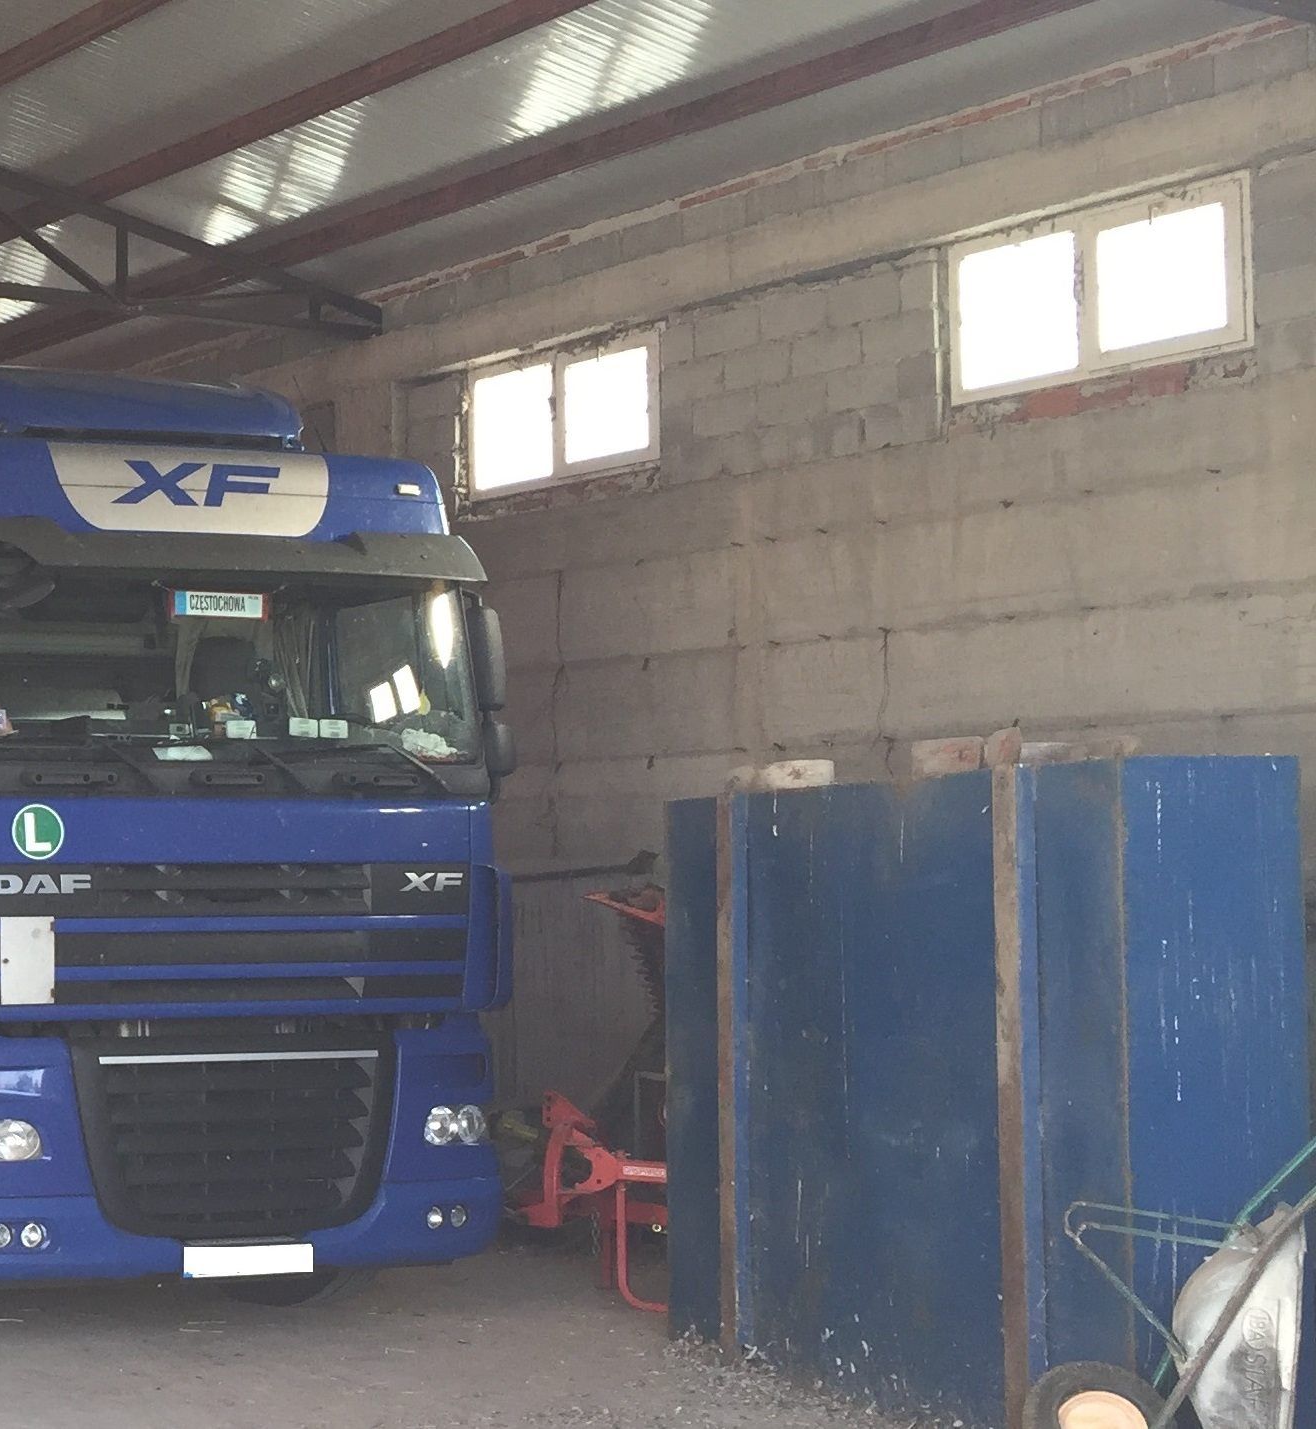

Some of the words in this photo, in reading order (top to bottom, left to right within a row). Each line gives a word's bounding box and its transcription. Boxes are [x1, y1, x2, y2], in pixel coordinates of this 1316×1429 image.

[110, 459, 281, 507] XF
[189, 594, 246, 613] CZĘSTOCHOWA
[24, 812, 52, 852] L
[399, 872, 463, 892] XF
